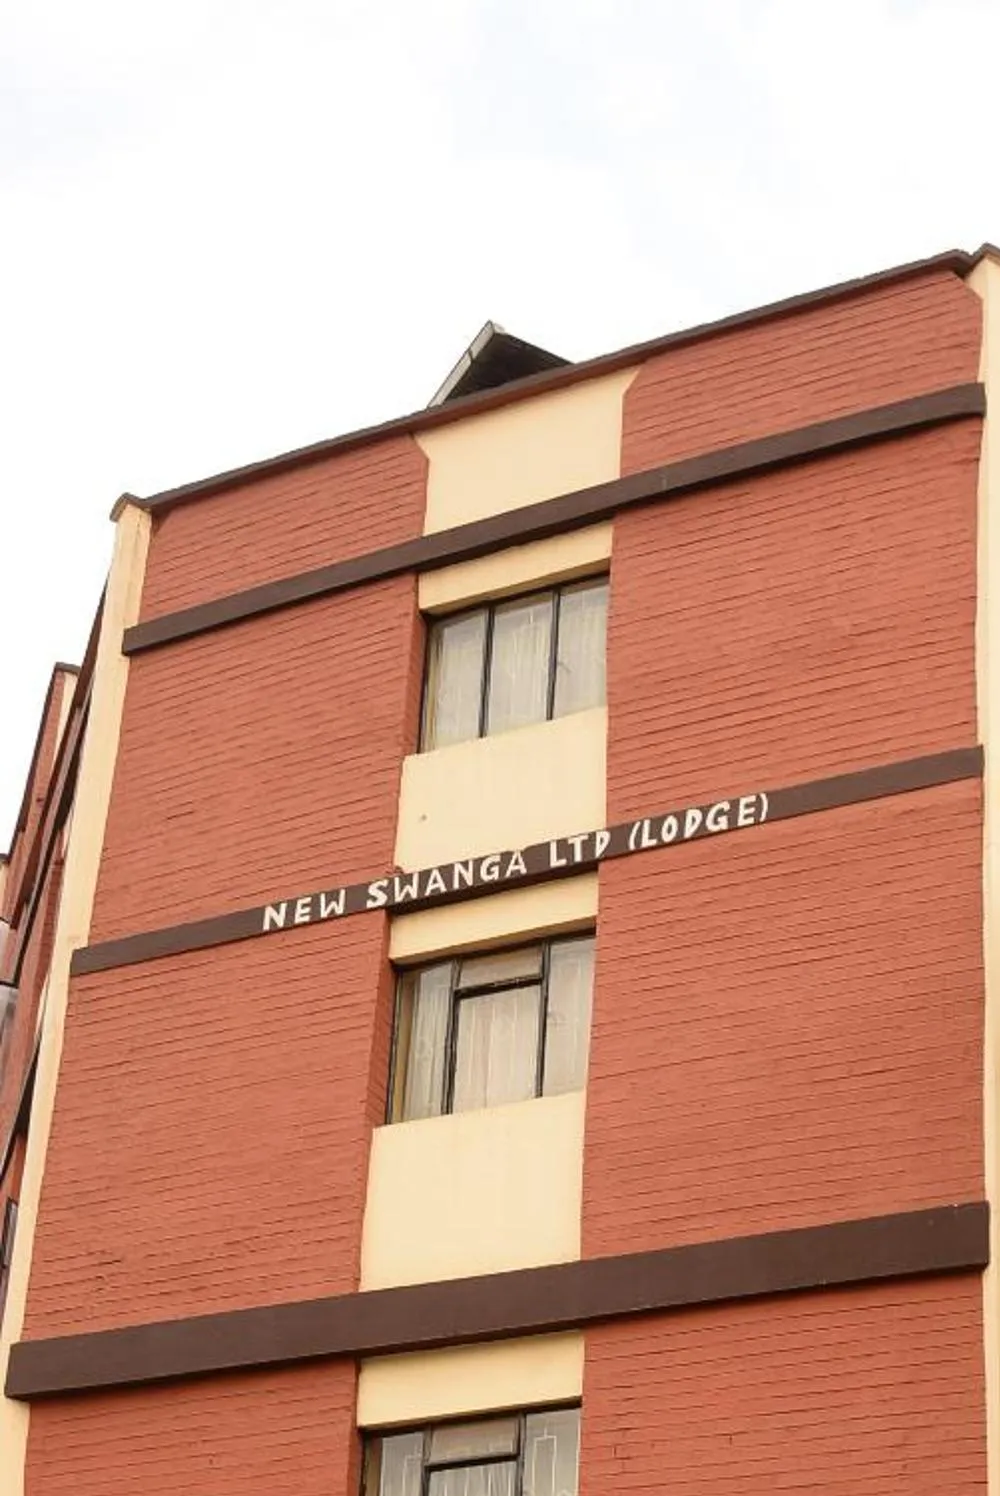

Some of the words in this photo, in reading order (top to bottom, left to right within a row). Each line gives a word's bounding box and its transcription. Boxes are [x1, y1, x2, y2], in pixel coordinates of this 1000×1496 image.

[262, 898, 346, 932] NEW
[366, 849, 527, 909] SWANGA
[549, 830, 612, 869] LTD
[628, 792, 769, 851] (LODGE)
